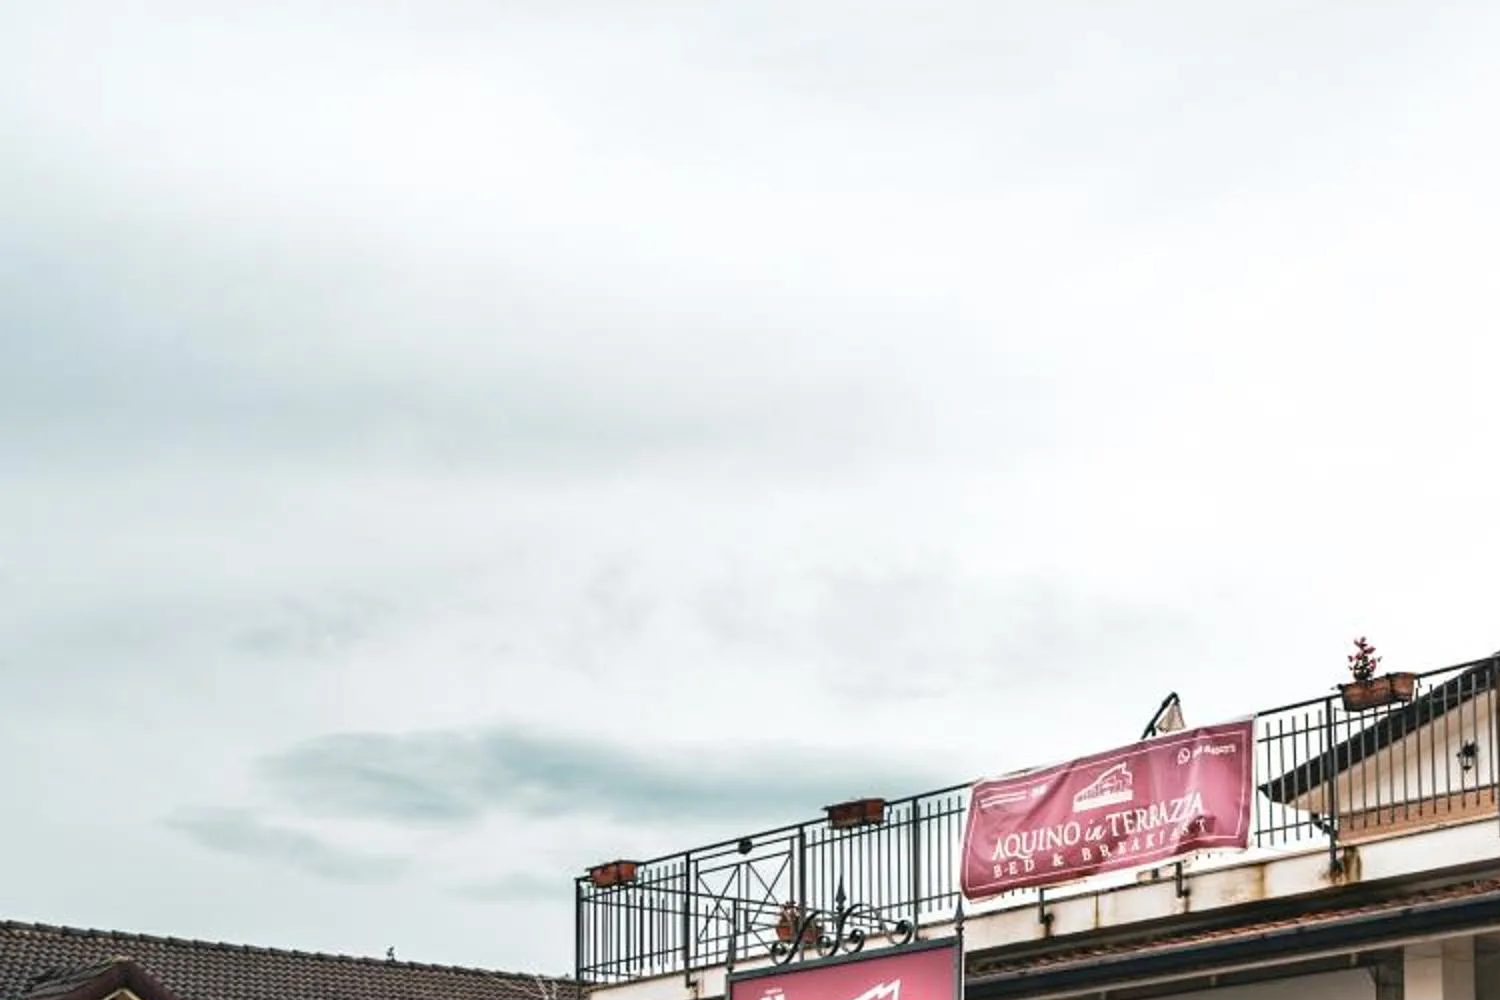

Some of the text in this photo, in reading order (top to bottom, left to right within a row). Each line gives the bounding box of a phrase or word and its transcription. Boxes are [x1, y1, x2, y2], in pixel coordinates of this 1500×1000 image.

[992, 822, 1081, 861] AQUINO
[1085, 819, 1105, 841] in
[994, 858, 1035, 878] BED
[1052, 853, 1064, 867] &
